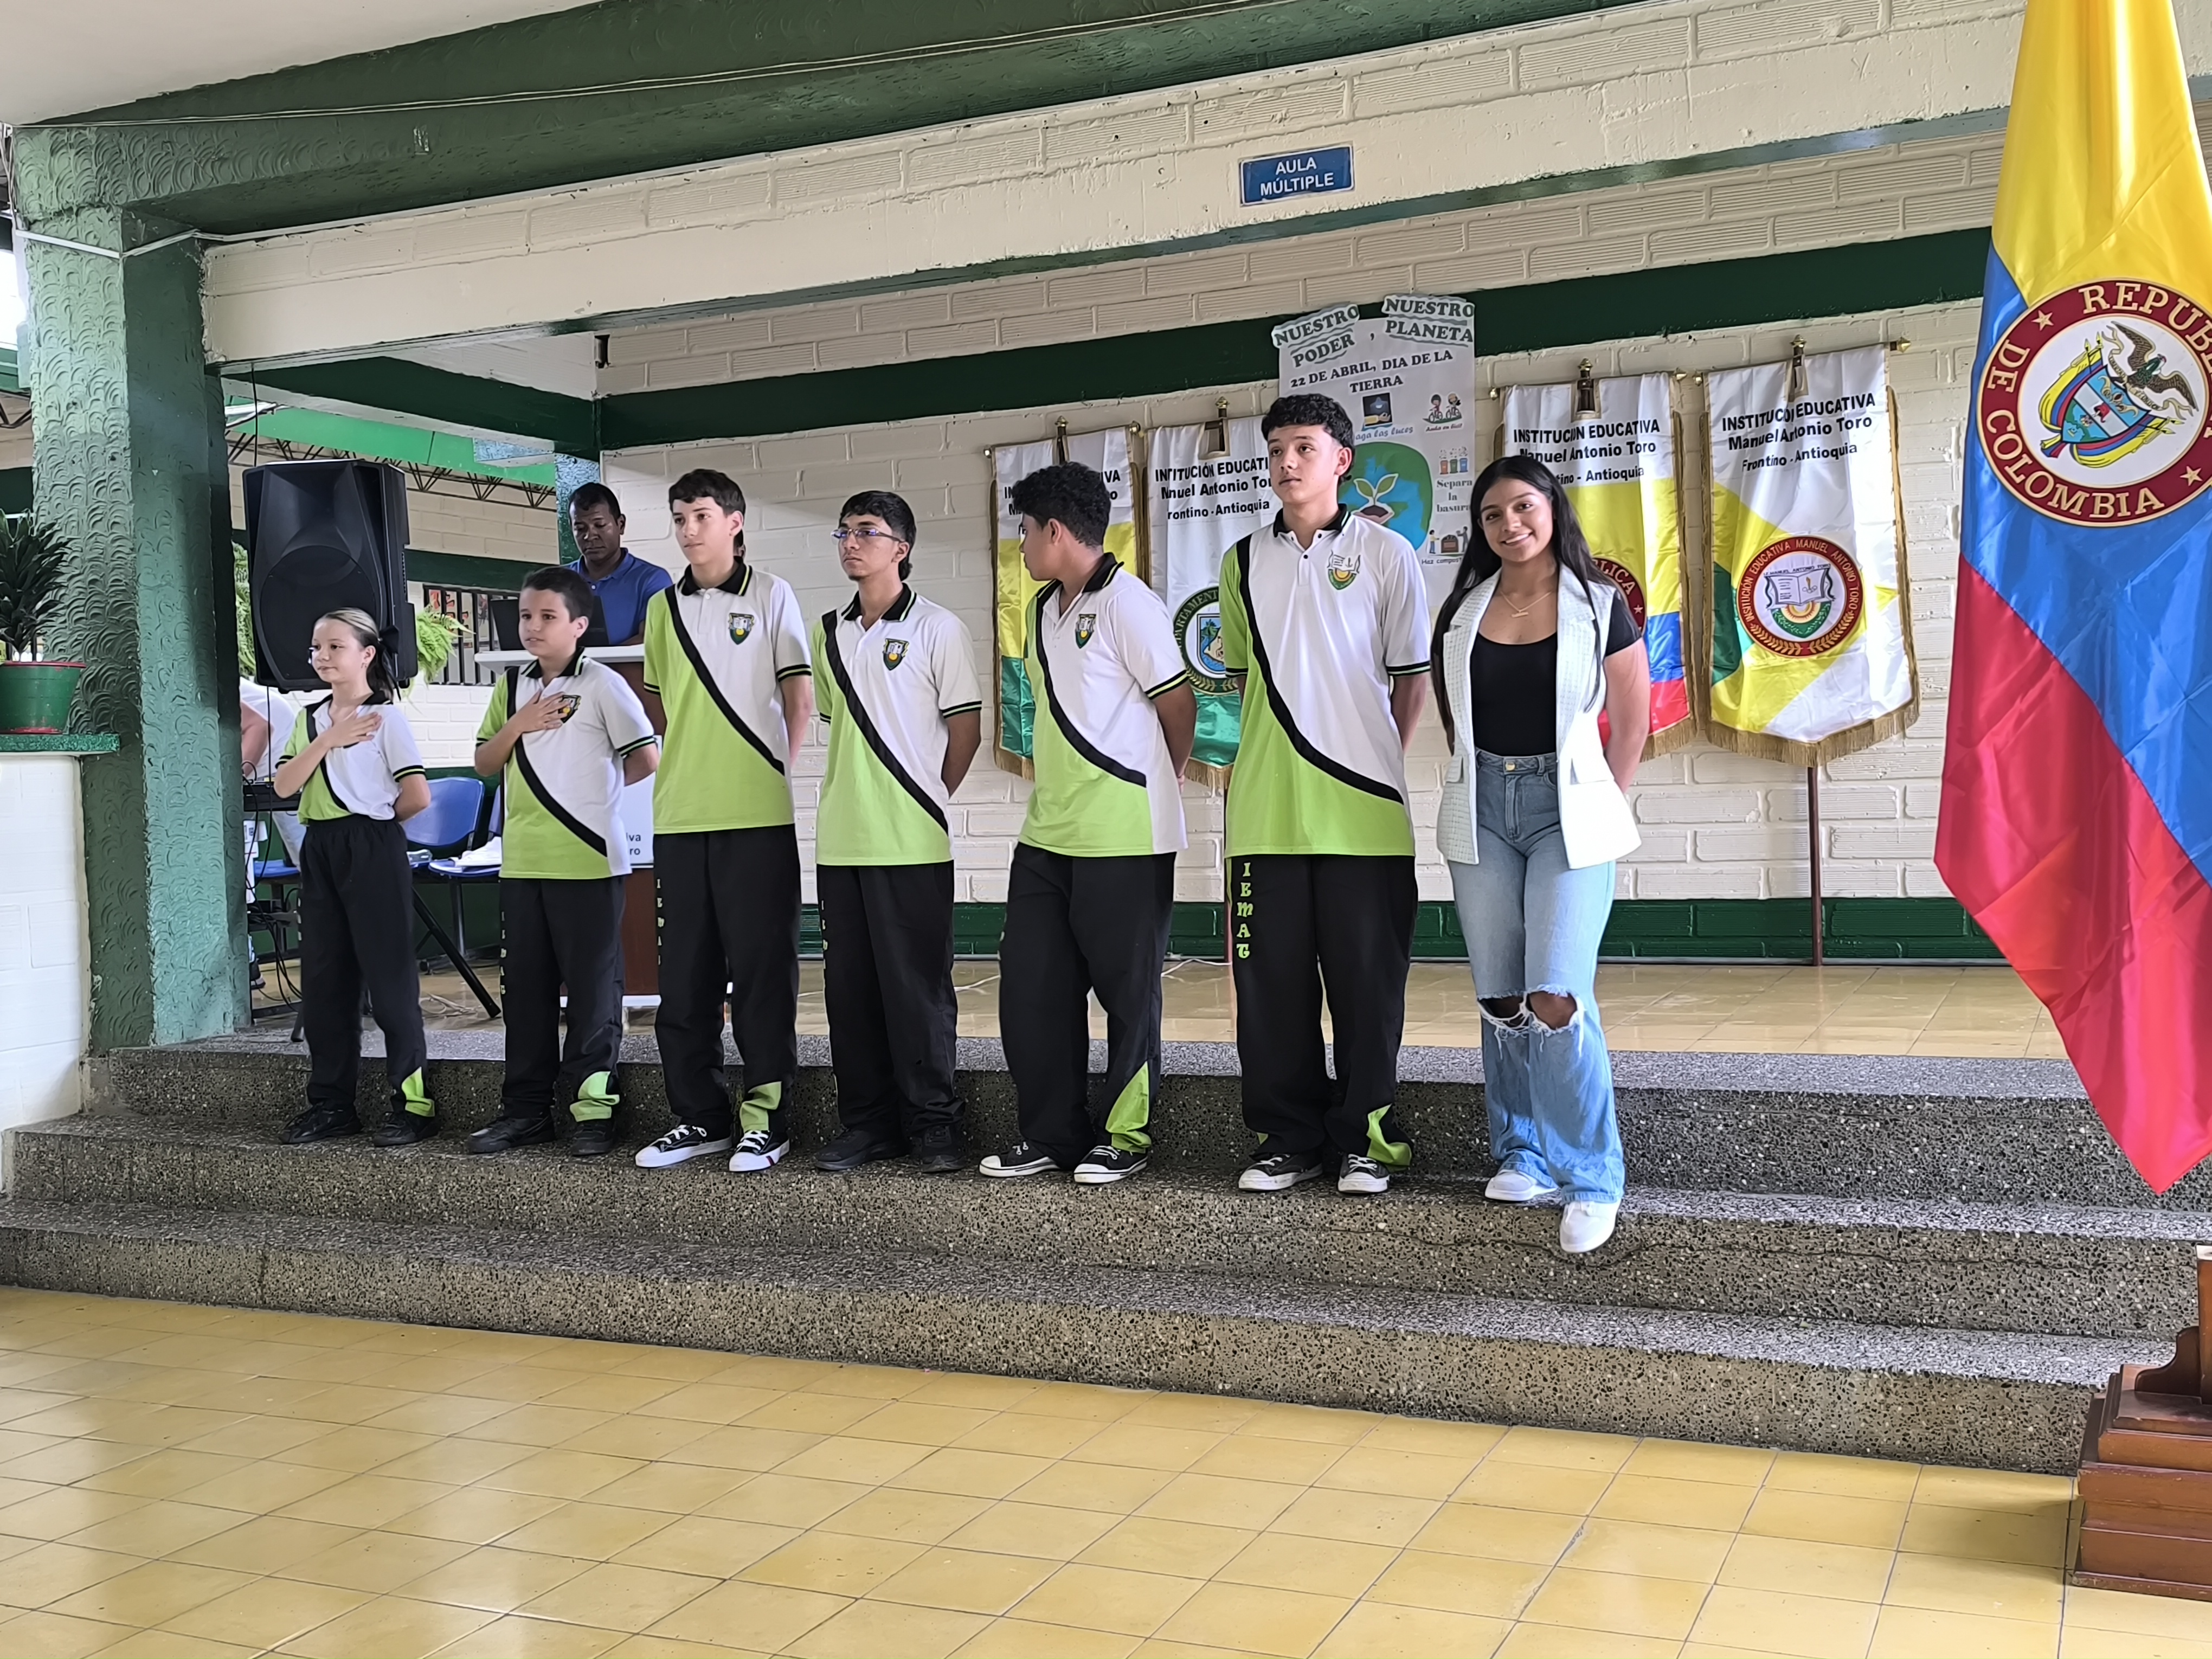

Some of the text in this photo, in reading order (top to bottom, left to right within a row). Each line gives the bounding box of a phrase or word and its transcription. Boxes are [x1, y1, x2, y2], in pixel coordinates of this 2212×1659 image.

[1275, 157, 1317, 176] AULA
[1260, 172, 1334, 196] MÚLTIPLE
[1384, 298, 1475, 318] NUESTRO
[1274, 305, 1359, 346] NUESTRO
[1385, 319, 1474, 343] PLANETA
[1292, 333, 1355, 368] PODER
[1290, 350, 1454, 388] 22 DE ABRIL, DIA DE LA
[1987, 339, 2030, 394] DE
[1349, 375, 1404, 393] TIERRA
[1796, 393, 1876, 418] EDUCATIVA
[1374, 429, 1388, 438] las
[1391, 426, 1413, 434] luces
[1589, 419, 1660, 439] EDUCATIVA
[1728, 429, 1779, 451] Manuel
[1836, 416, 1872, 432] Toro
[1570, 443, 1622, 461] Antonio
[1626, 440, 1656, 455] Toro
[1795, 442, 1857, 464] Antioquia
[1217, 456, 1269, 475] EDUCATI
[1585, 465, 1644, 482] Antioquia
[1986, 409, 2165, 519] COLOMBIA
[1199, 479, 1249, 496] Antonio
[1436, 479, 1472, 490] Separa
[1448, 492, 1457, 501] la
[1167, 506, 1209, 520] rontino
[1216, 499, 1270, 516] Antioquia
[1750, 541, 1791, 575] EDUCATIVA
[1796, 539, 1829, 554] MANUEL
[1849, 584, 1859, 610] TORO
